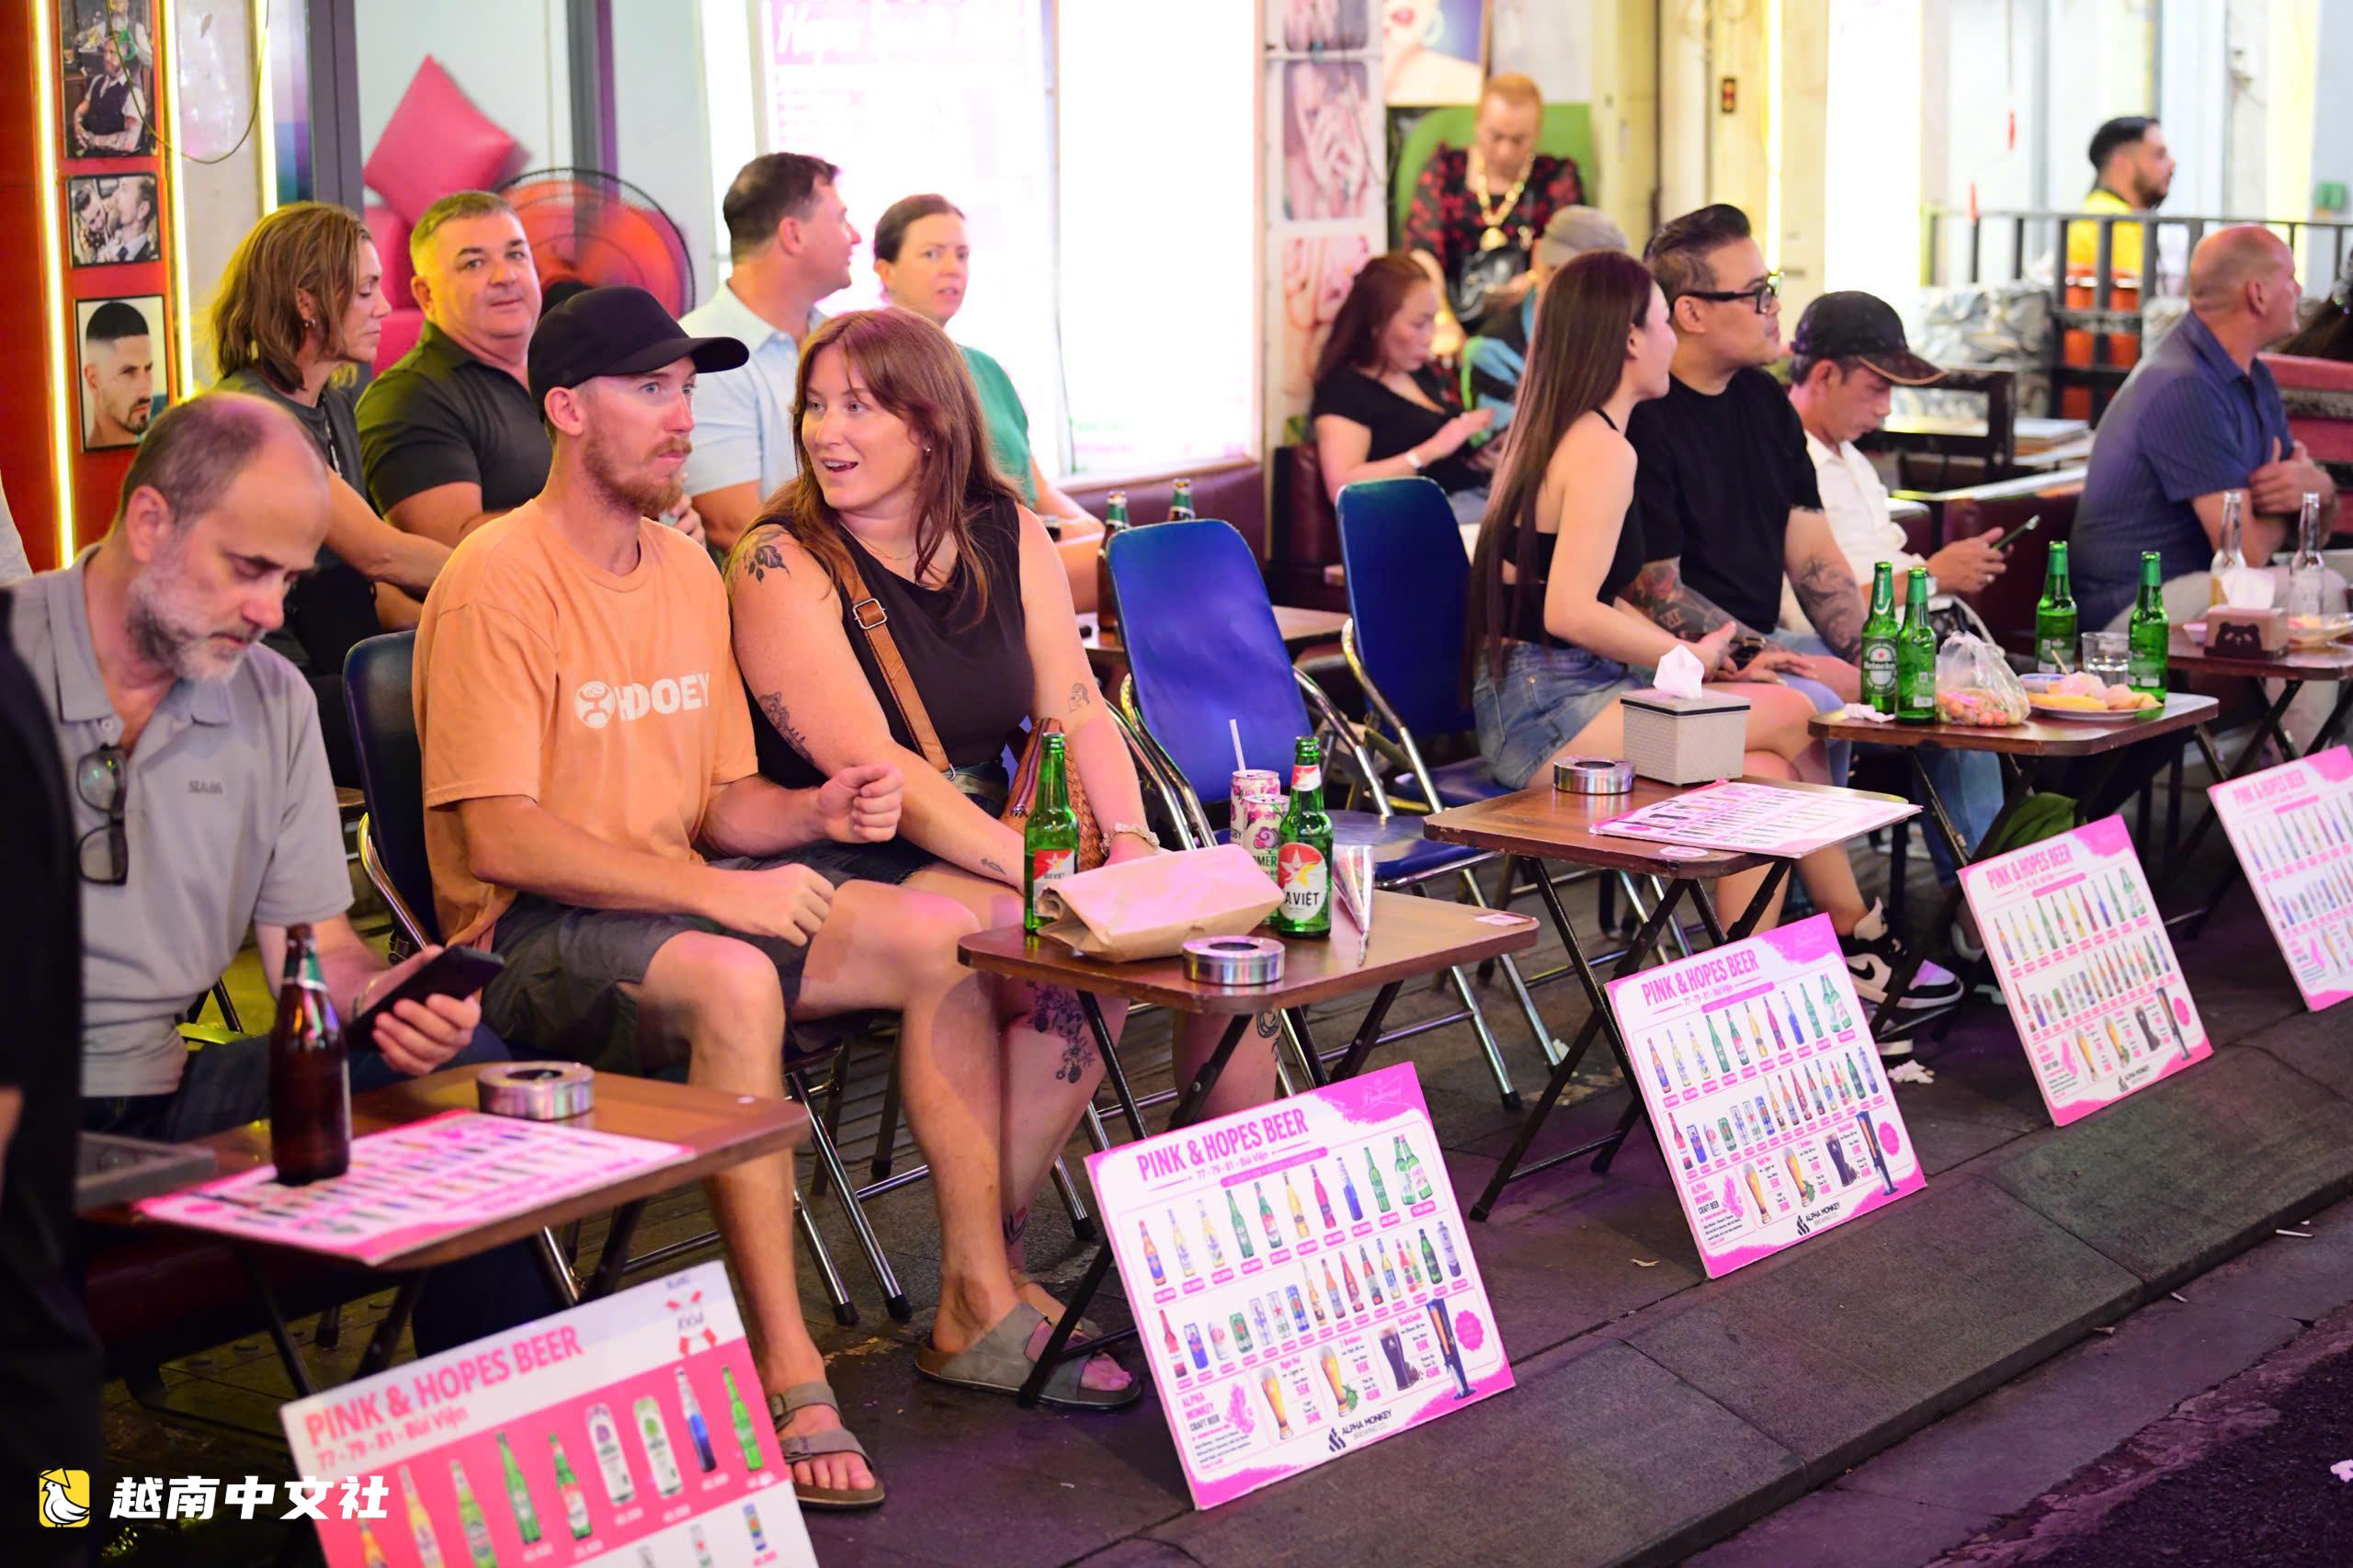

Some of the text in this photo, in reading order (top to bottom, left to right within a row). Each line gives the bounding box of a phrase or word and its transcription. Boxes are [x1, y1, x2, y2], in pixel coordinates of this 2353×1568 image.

[1641, 949, 1760, 1006] PINK & HOPES BEER
[1136, 1143, 1188, 1182] PINK
[1188, 1139, 1205, 1165] &
[1201, 1121, 1263, 1163] HOPES
[1261, 1108, 1310, 1143] BEER
[303, 1324, 585, 1448] PINK & HOPES BEER
[1342, 1408, 1392, 1436] ALPHA MONKEY
